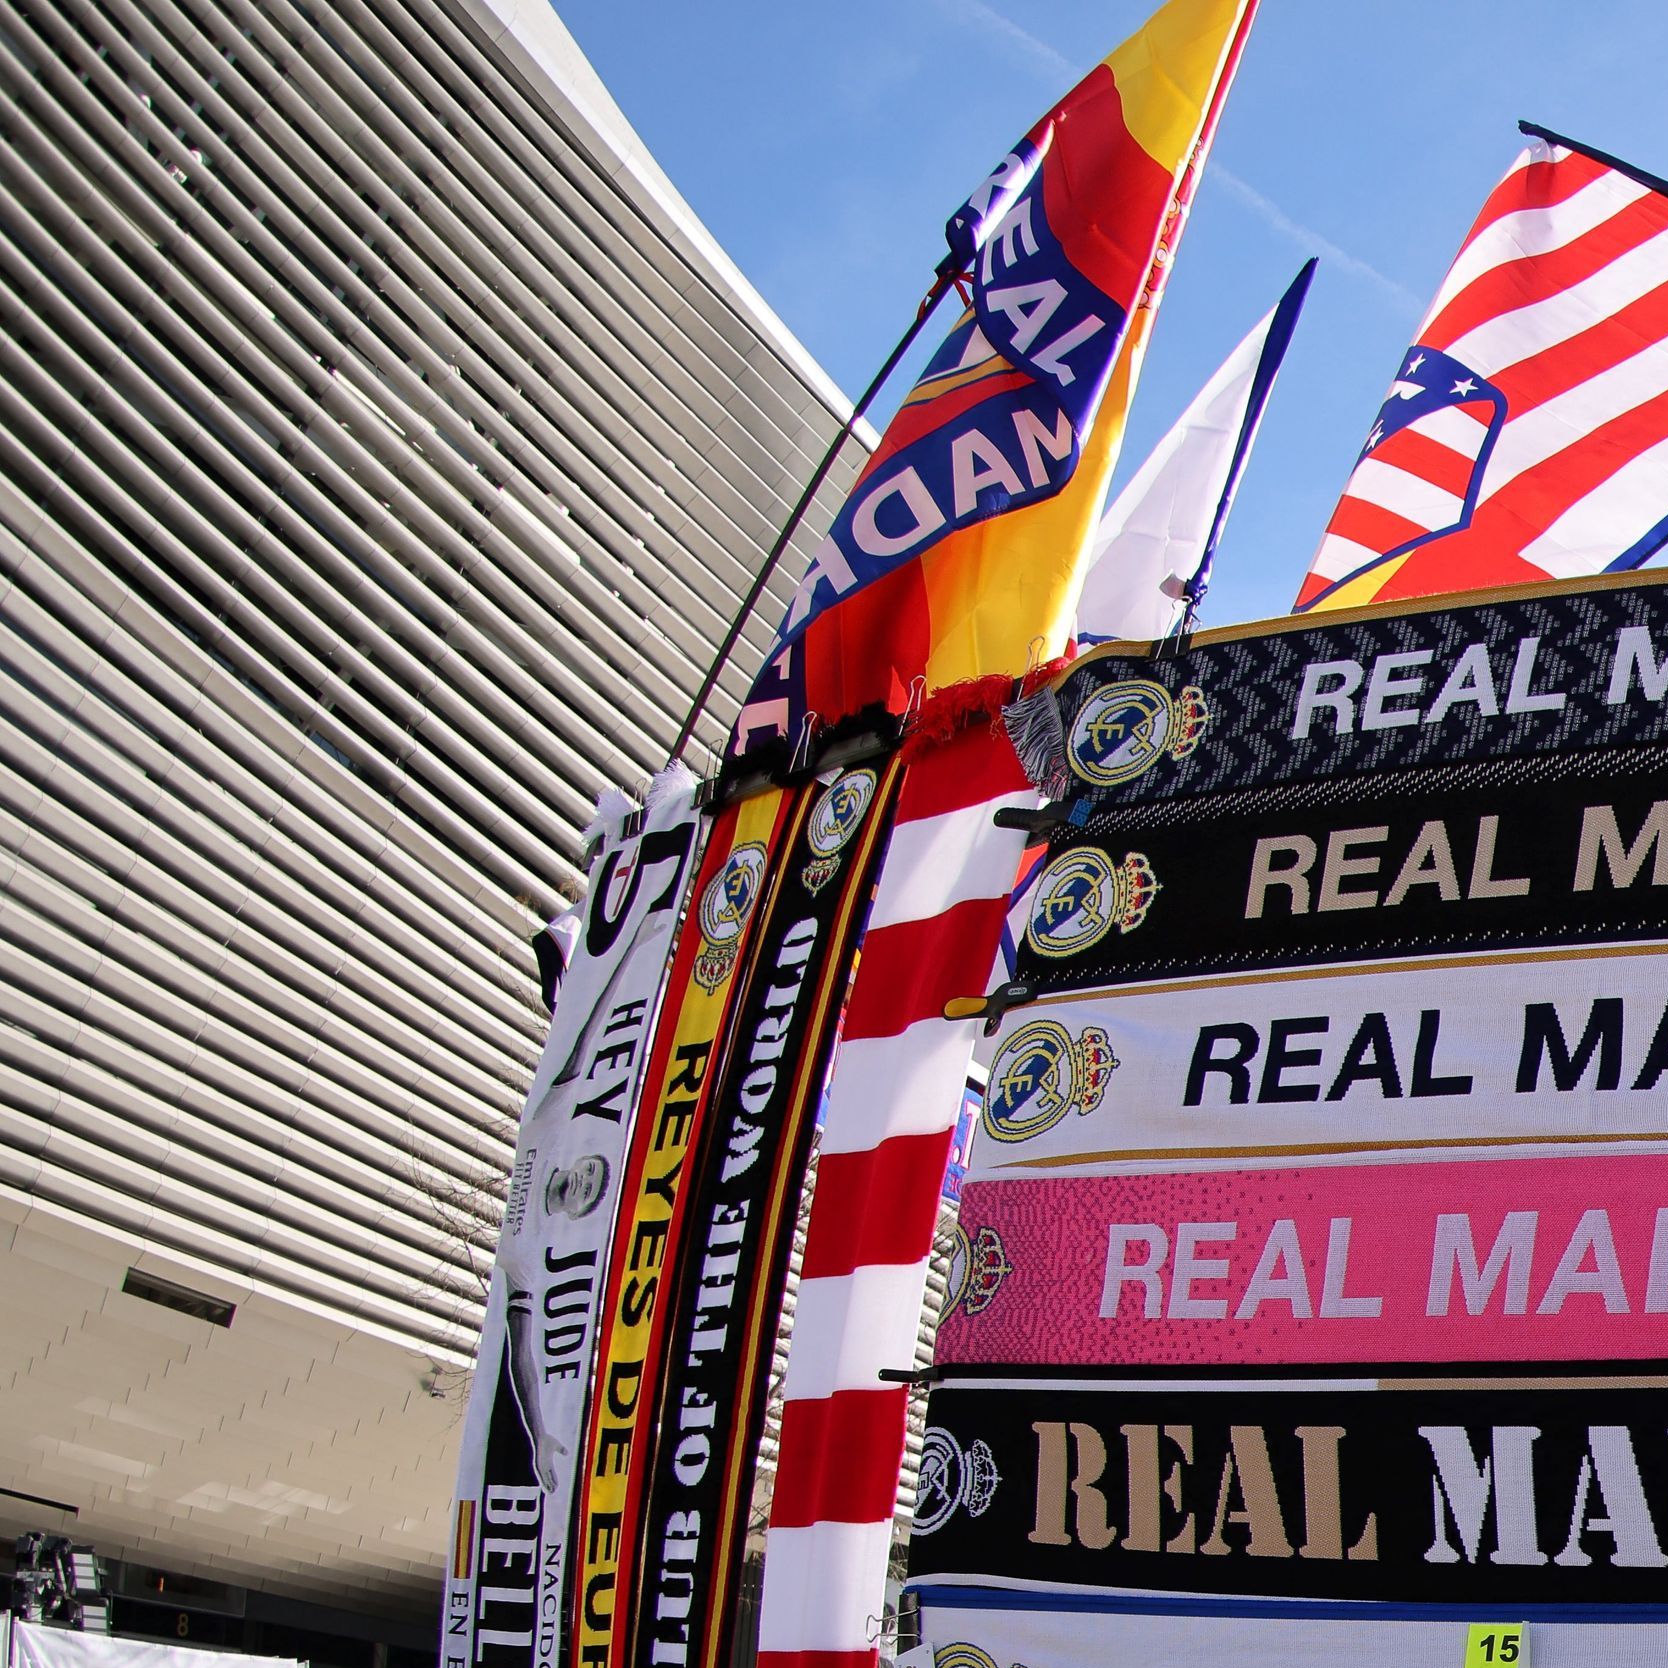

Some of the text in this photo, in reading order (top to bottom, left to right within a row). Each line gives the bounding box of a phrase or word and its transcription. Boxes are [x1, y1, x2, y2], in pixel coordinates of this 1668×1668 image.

[1290, 636, 1566, 740] REAL
[1243, 815, 1531, 920] REAL
[572, 996, 648, 1125] HEY
[720, 916, 819, 1184] WORLD
[1182, 1009, 1473, 1107] REAL
[618, 1040, 713, 1329] REYES
[544, 1246, 598, 1387] JUDE
[689, 1198, 750, 1368] THE
[1097, 1217, 1383, 1320] REAL
[595, 1360, 639, 1478] DE
[673, 1380, 716, 1487] OF
[1027, 1421, 1380, 1562] REAL
[448, 1590, 468, 1637] EN
[1477, 1634, 1520, 1664] 15
